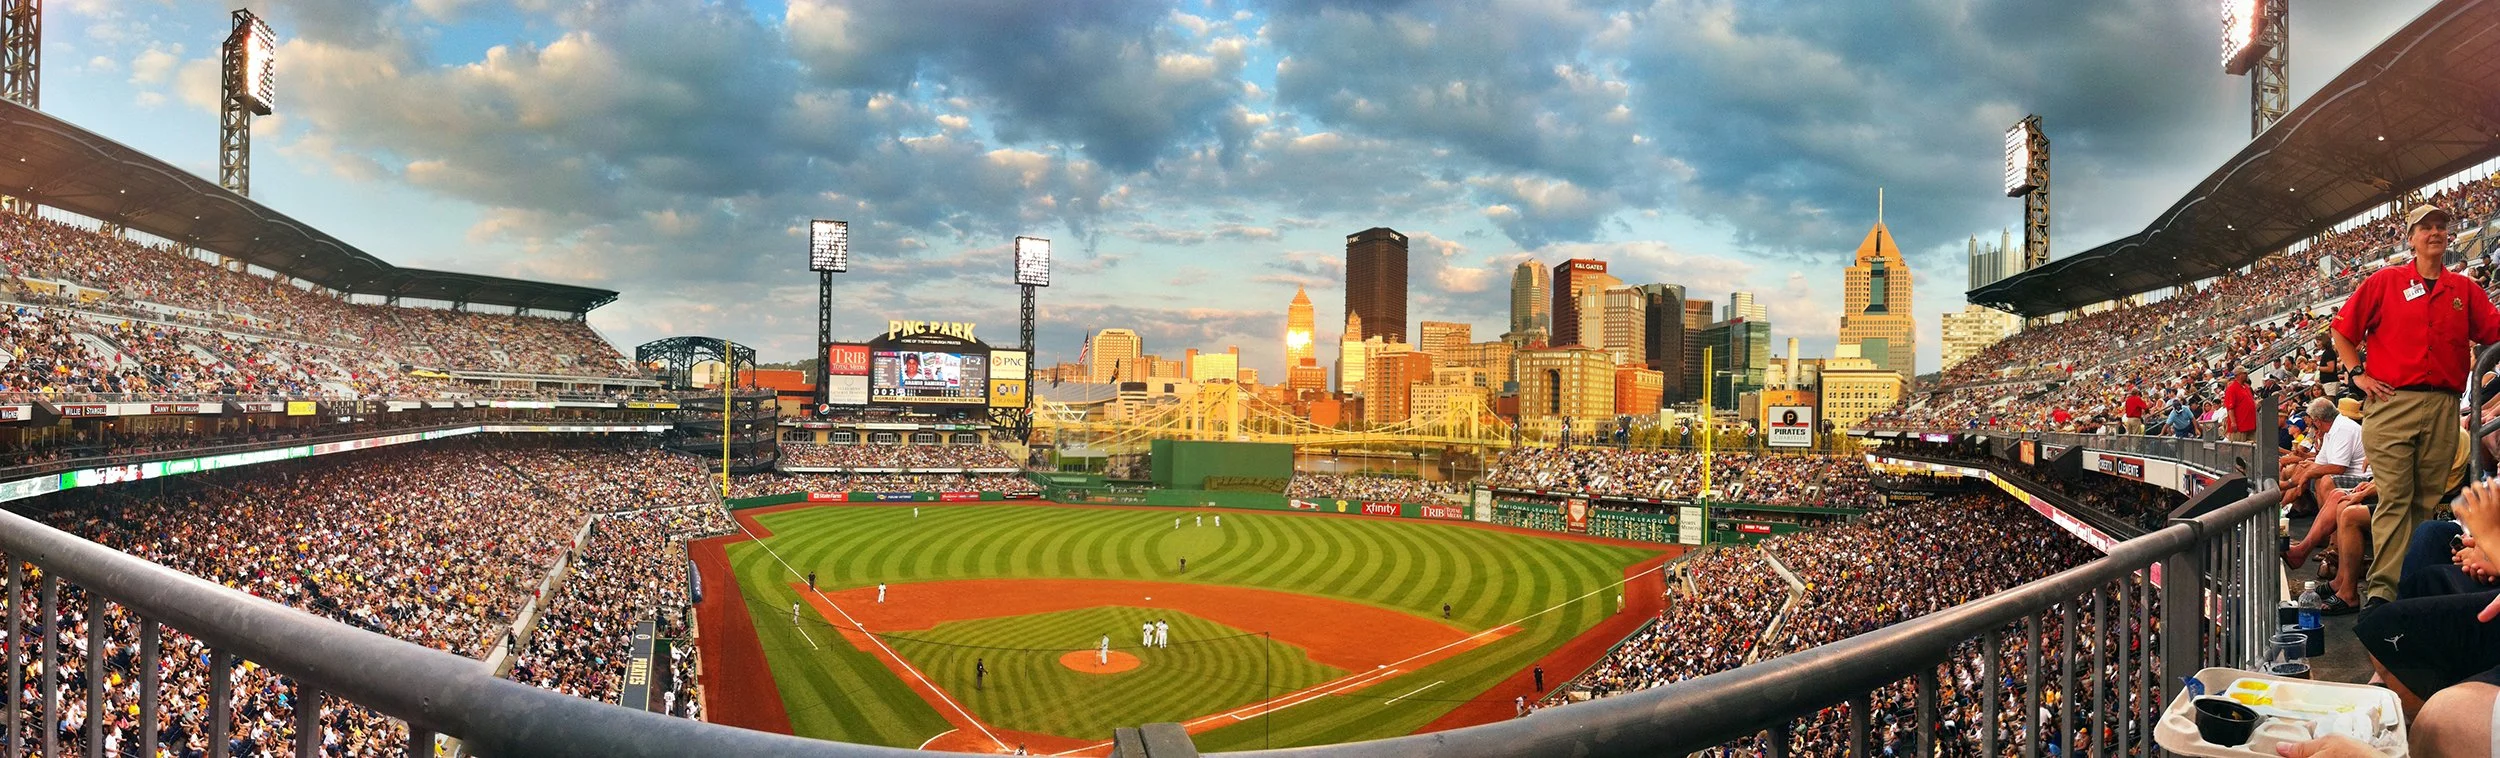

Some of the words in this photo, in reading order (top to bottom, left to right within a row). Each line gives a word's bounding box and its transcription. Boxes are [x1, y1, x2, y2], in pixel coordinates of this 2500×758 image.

[1586, 263, 1604, 271] GATES
[888, 319, 926, 341] PNC
[929, 321, 977, 344] PARK
[832, 348, 867, 364] TRIB
[1004, 357, 1024, 366] PNC
[64, 407, 81, 416] WILLIE
[86, 406, 106, 415] STARGELL
[153, 404, 169, 413] DANNY
[1786, 413, 1794, 424] P
[1774, 428, 1806, 436] PIRATES
[2117, 460, 2140, 478] CLEMENTE
[1366, 503, 1396, 515] xfinity
[1421, 505, 1445, 517] TRIB
[1499, 504, 1530, 512] NATIONAL
[1596, 514, 1636, 522] AMERICAN
[629, 657, 648, 685] PIRATES
